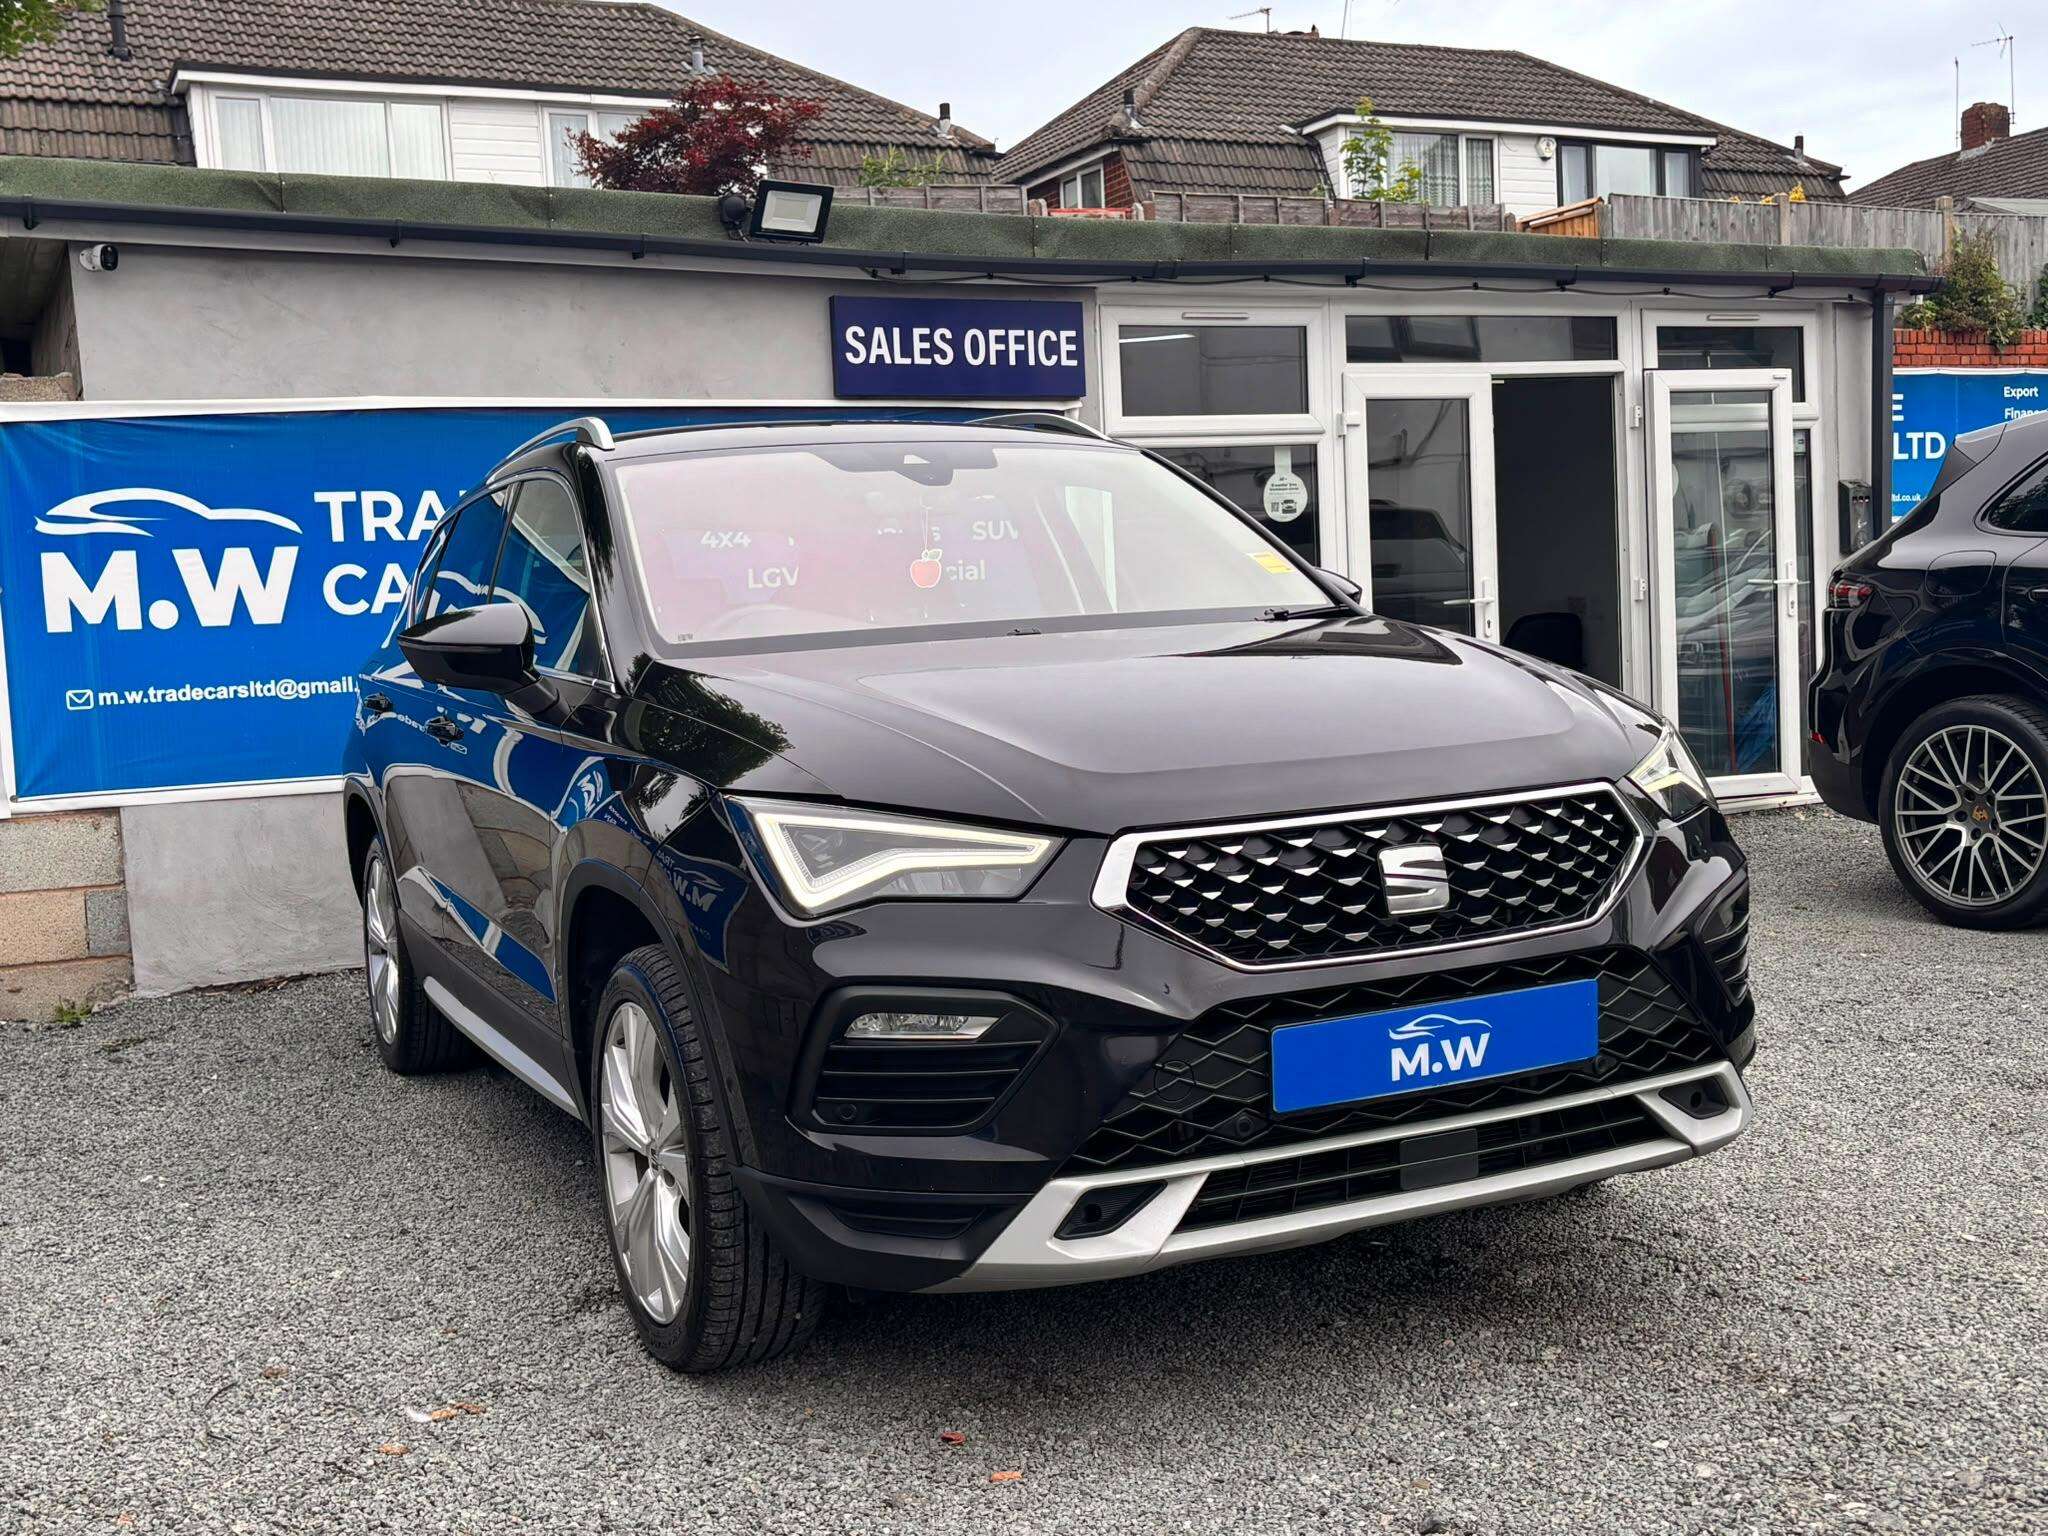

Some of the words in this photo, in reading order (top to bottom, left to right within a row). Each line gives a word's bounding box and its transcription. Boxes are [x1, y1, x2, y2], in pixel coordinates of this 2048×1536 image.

[844, 325, 955, 366] SALES
[963, 328, 1079, 367] OFFICE
[2003, 386, 2039, 400] Export
[1893, 431, 1946, 460] LTD
[313, 489, 467, 543] TRA
[39, 545, 300, 634] M.W
[747, 566, 800, 590] LGV
[1390, 1031, 1492, 1083] M.W
